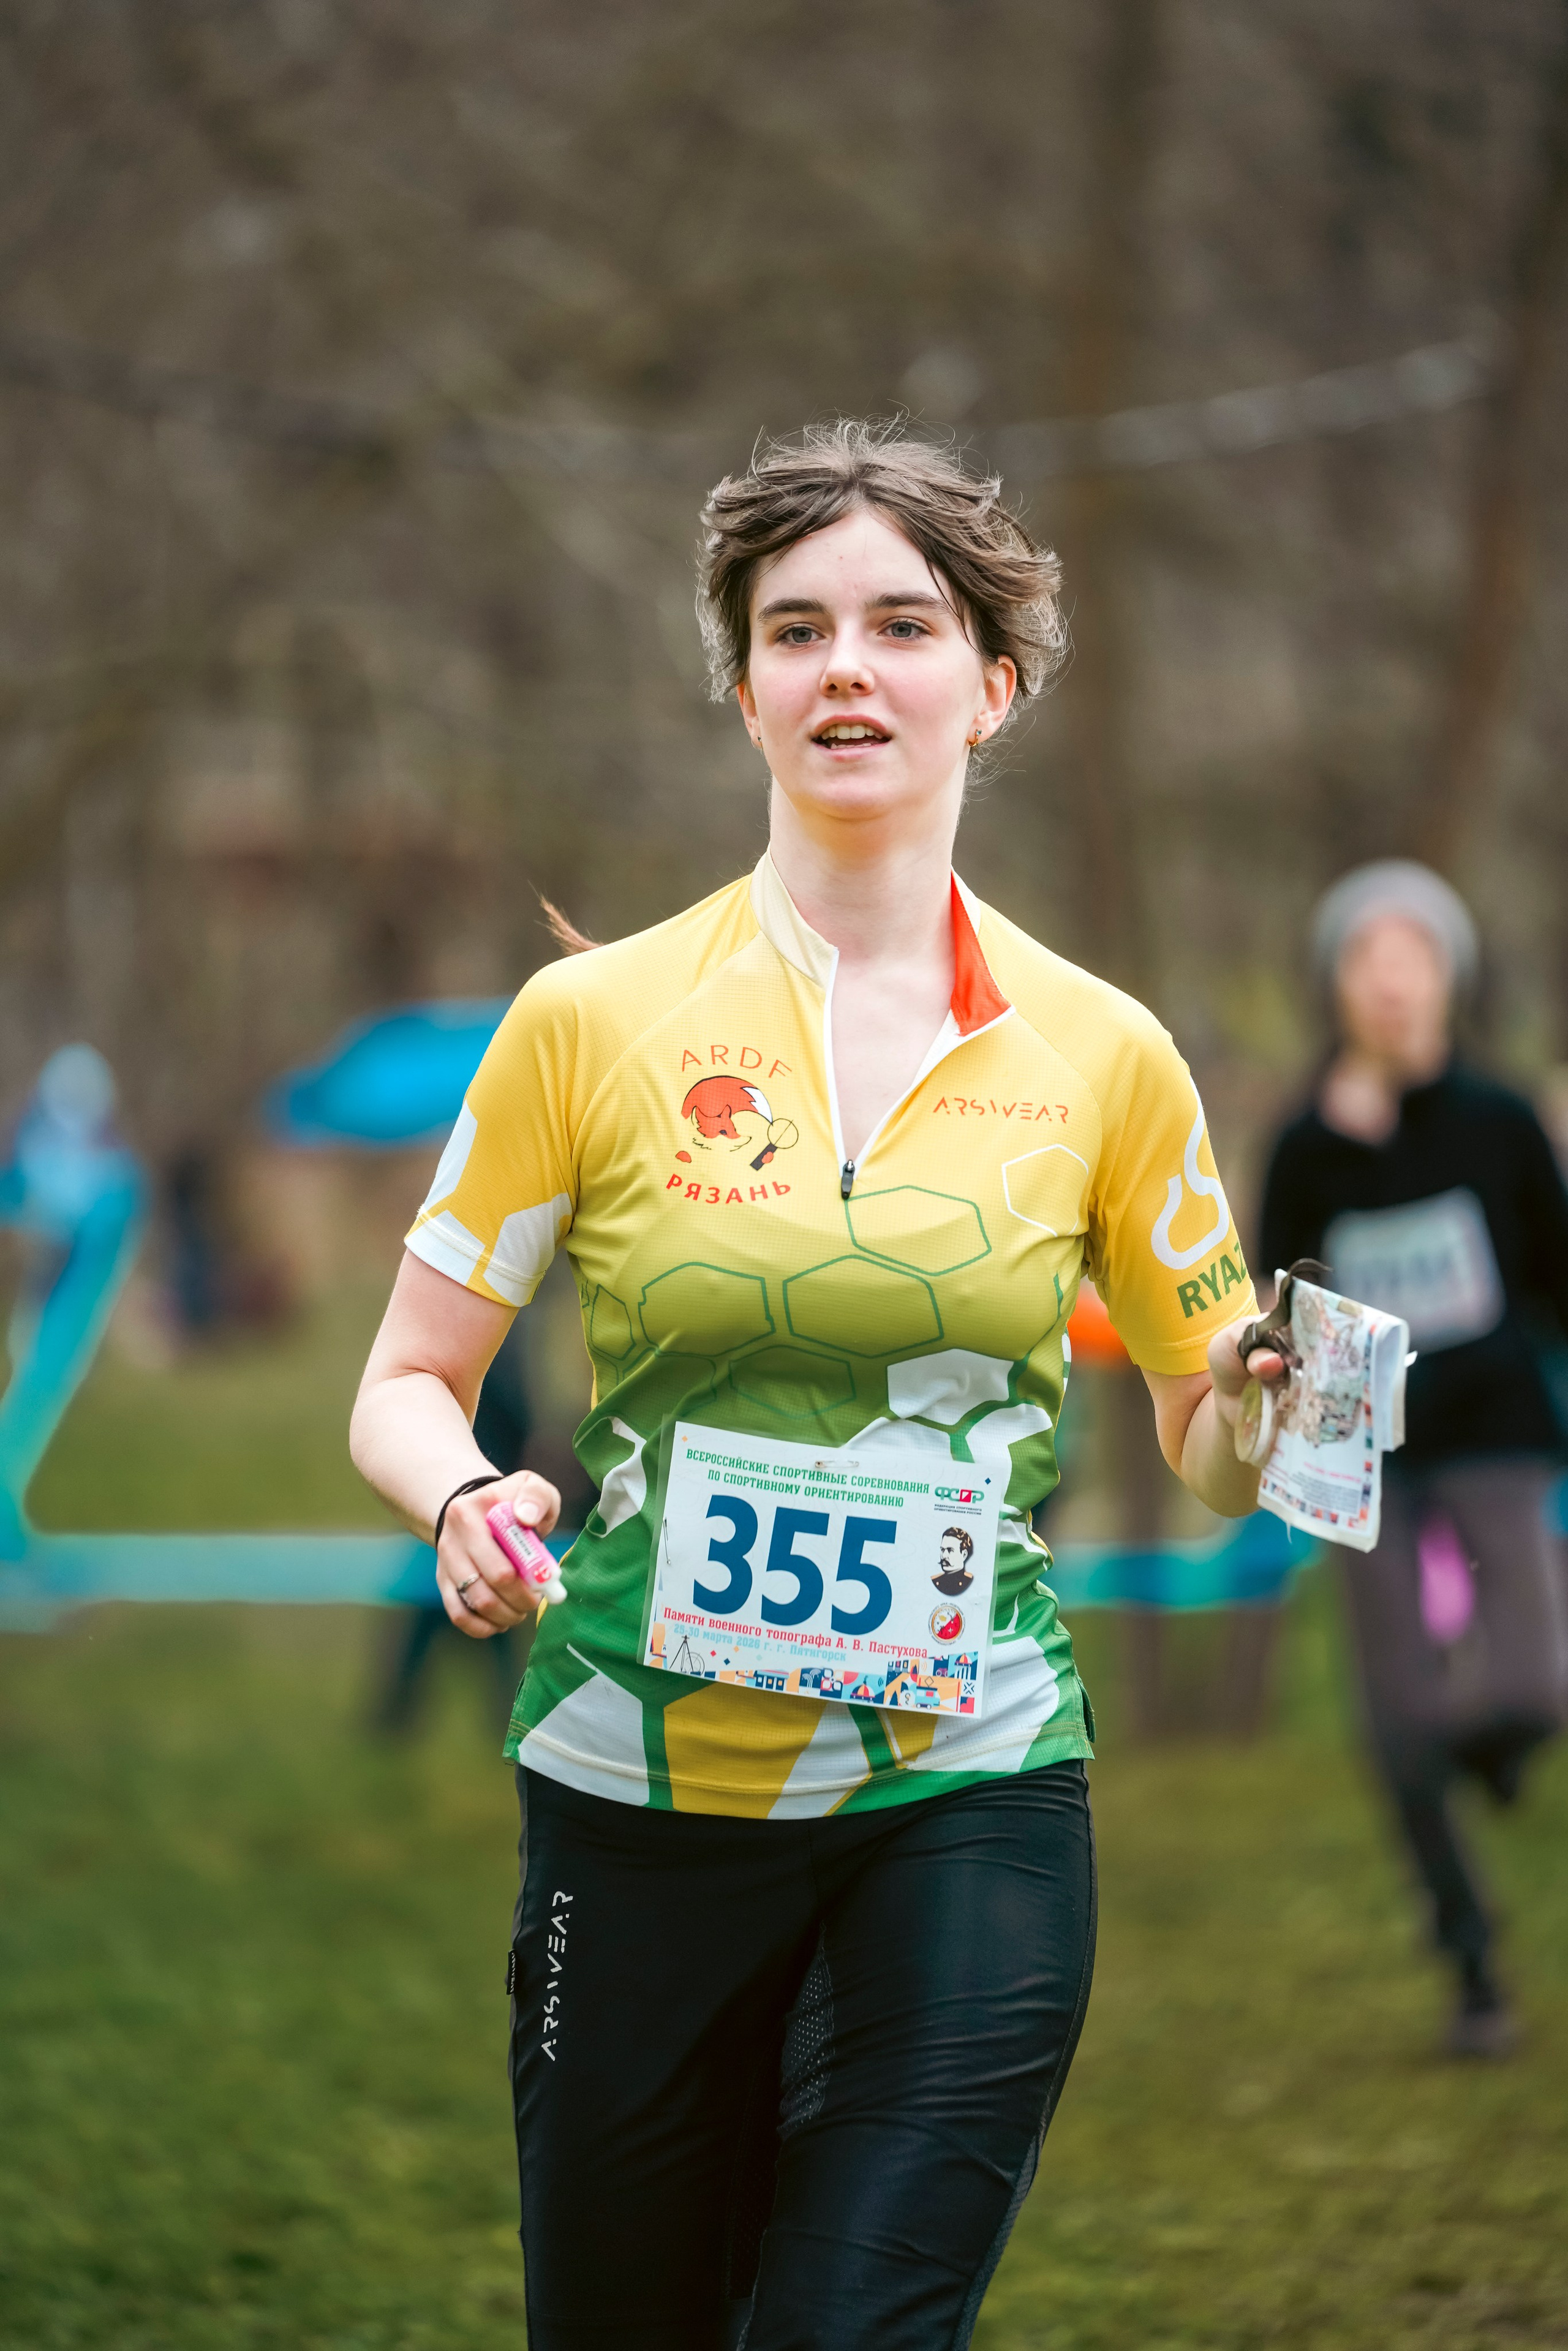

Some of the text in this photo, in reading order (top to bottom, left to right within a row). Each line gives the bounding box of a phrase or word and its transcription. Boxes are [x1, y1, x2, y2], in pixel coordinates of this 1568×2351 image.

[682, 1044, 792, 1078] ARDF
[933, 1096, 1068, 1123] ARSWEAR
[666, 1173, 791, 1204] РЯЗАНЬ
[686, 1448, 930, 1493] ВСЕРОССИЙСКИЕ СПОРТИВНЫЕ СОРЕВНОВАНИЯ
[707, 1470, 904, 1507] ПО СПОРТИВНОМУ ОРИЕНТИРОВАНИЮ
[693, 1494, 897, 1636] 355
[663, 1607, 928, 1658] Памяти военного топографа А. В. Пастухова
[703, 1631, 733, 1645] марта
[790, 1644, 846, 1661] Пятигорск
